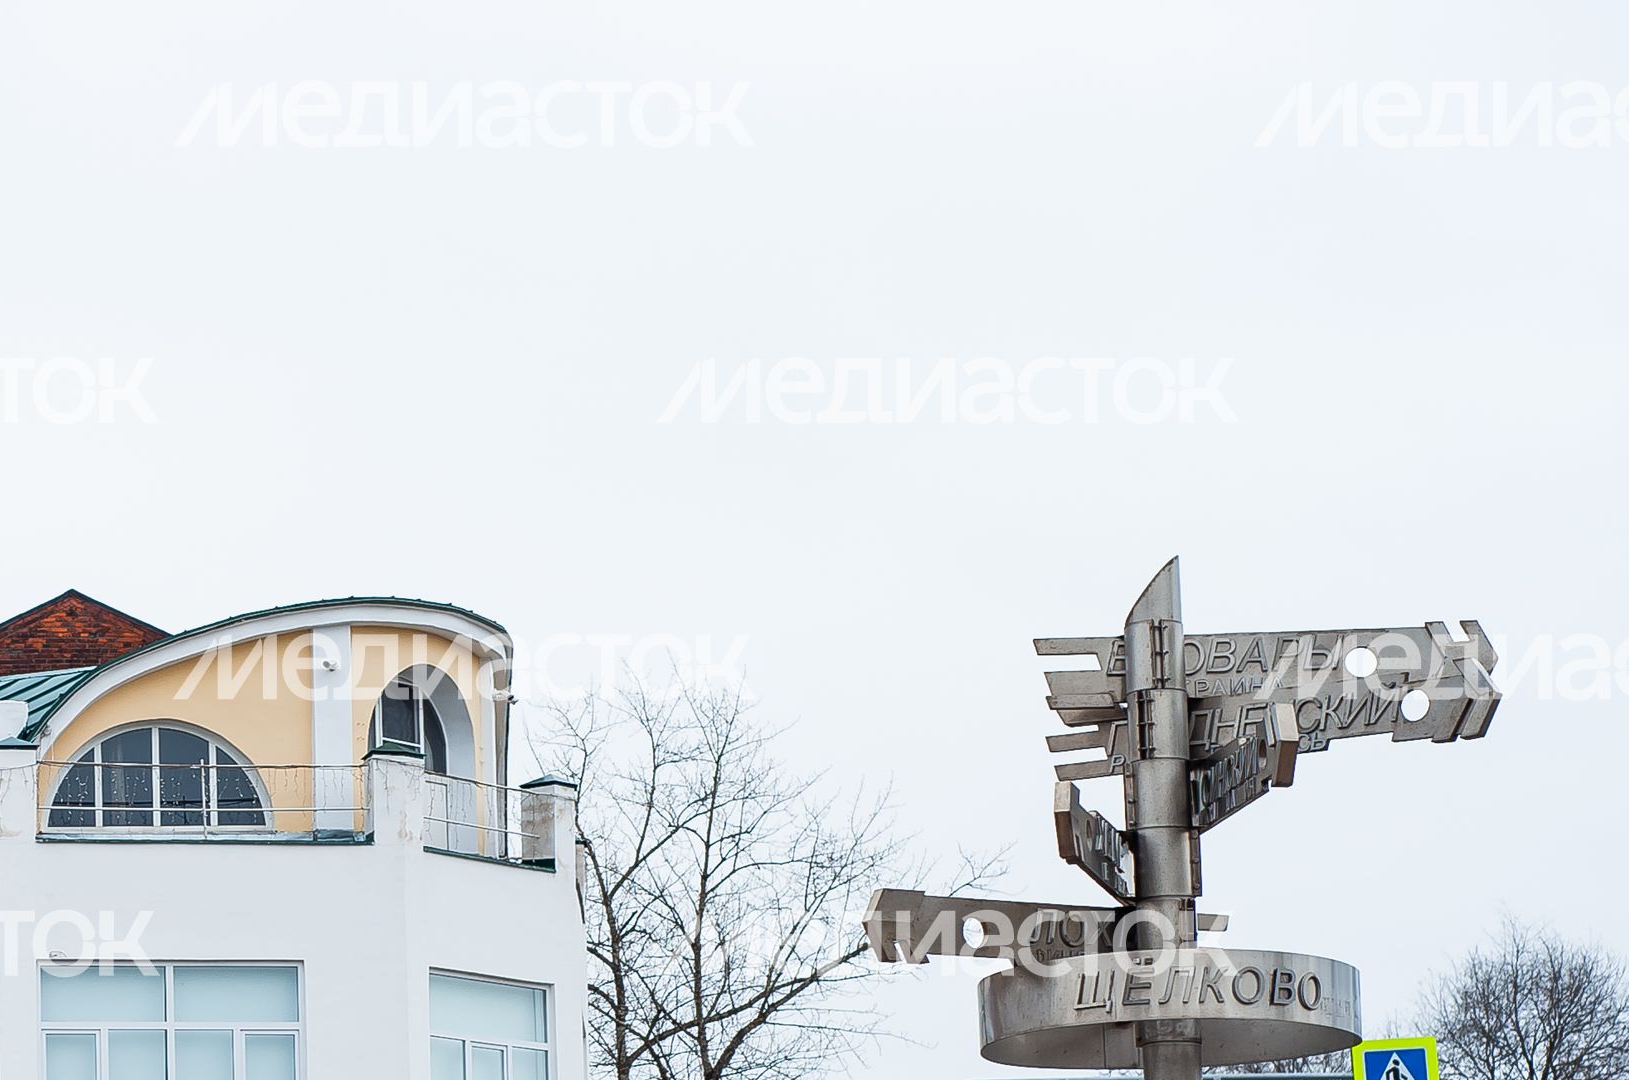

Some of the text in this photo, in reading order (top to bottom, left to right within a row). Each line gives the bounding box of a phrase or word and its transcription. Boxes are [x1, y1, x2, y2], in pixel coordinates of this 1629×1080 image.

[1107, 634, 1344, 676] БОВАРЫ
[1184, 676, 1284, 697] РАИНА
[1074, 956, 1322, 1013] ЩЁЛКОВО
